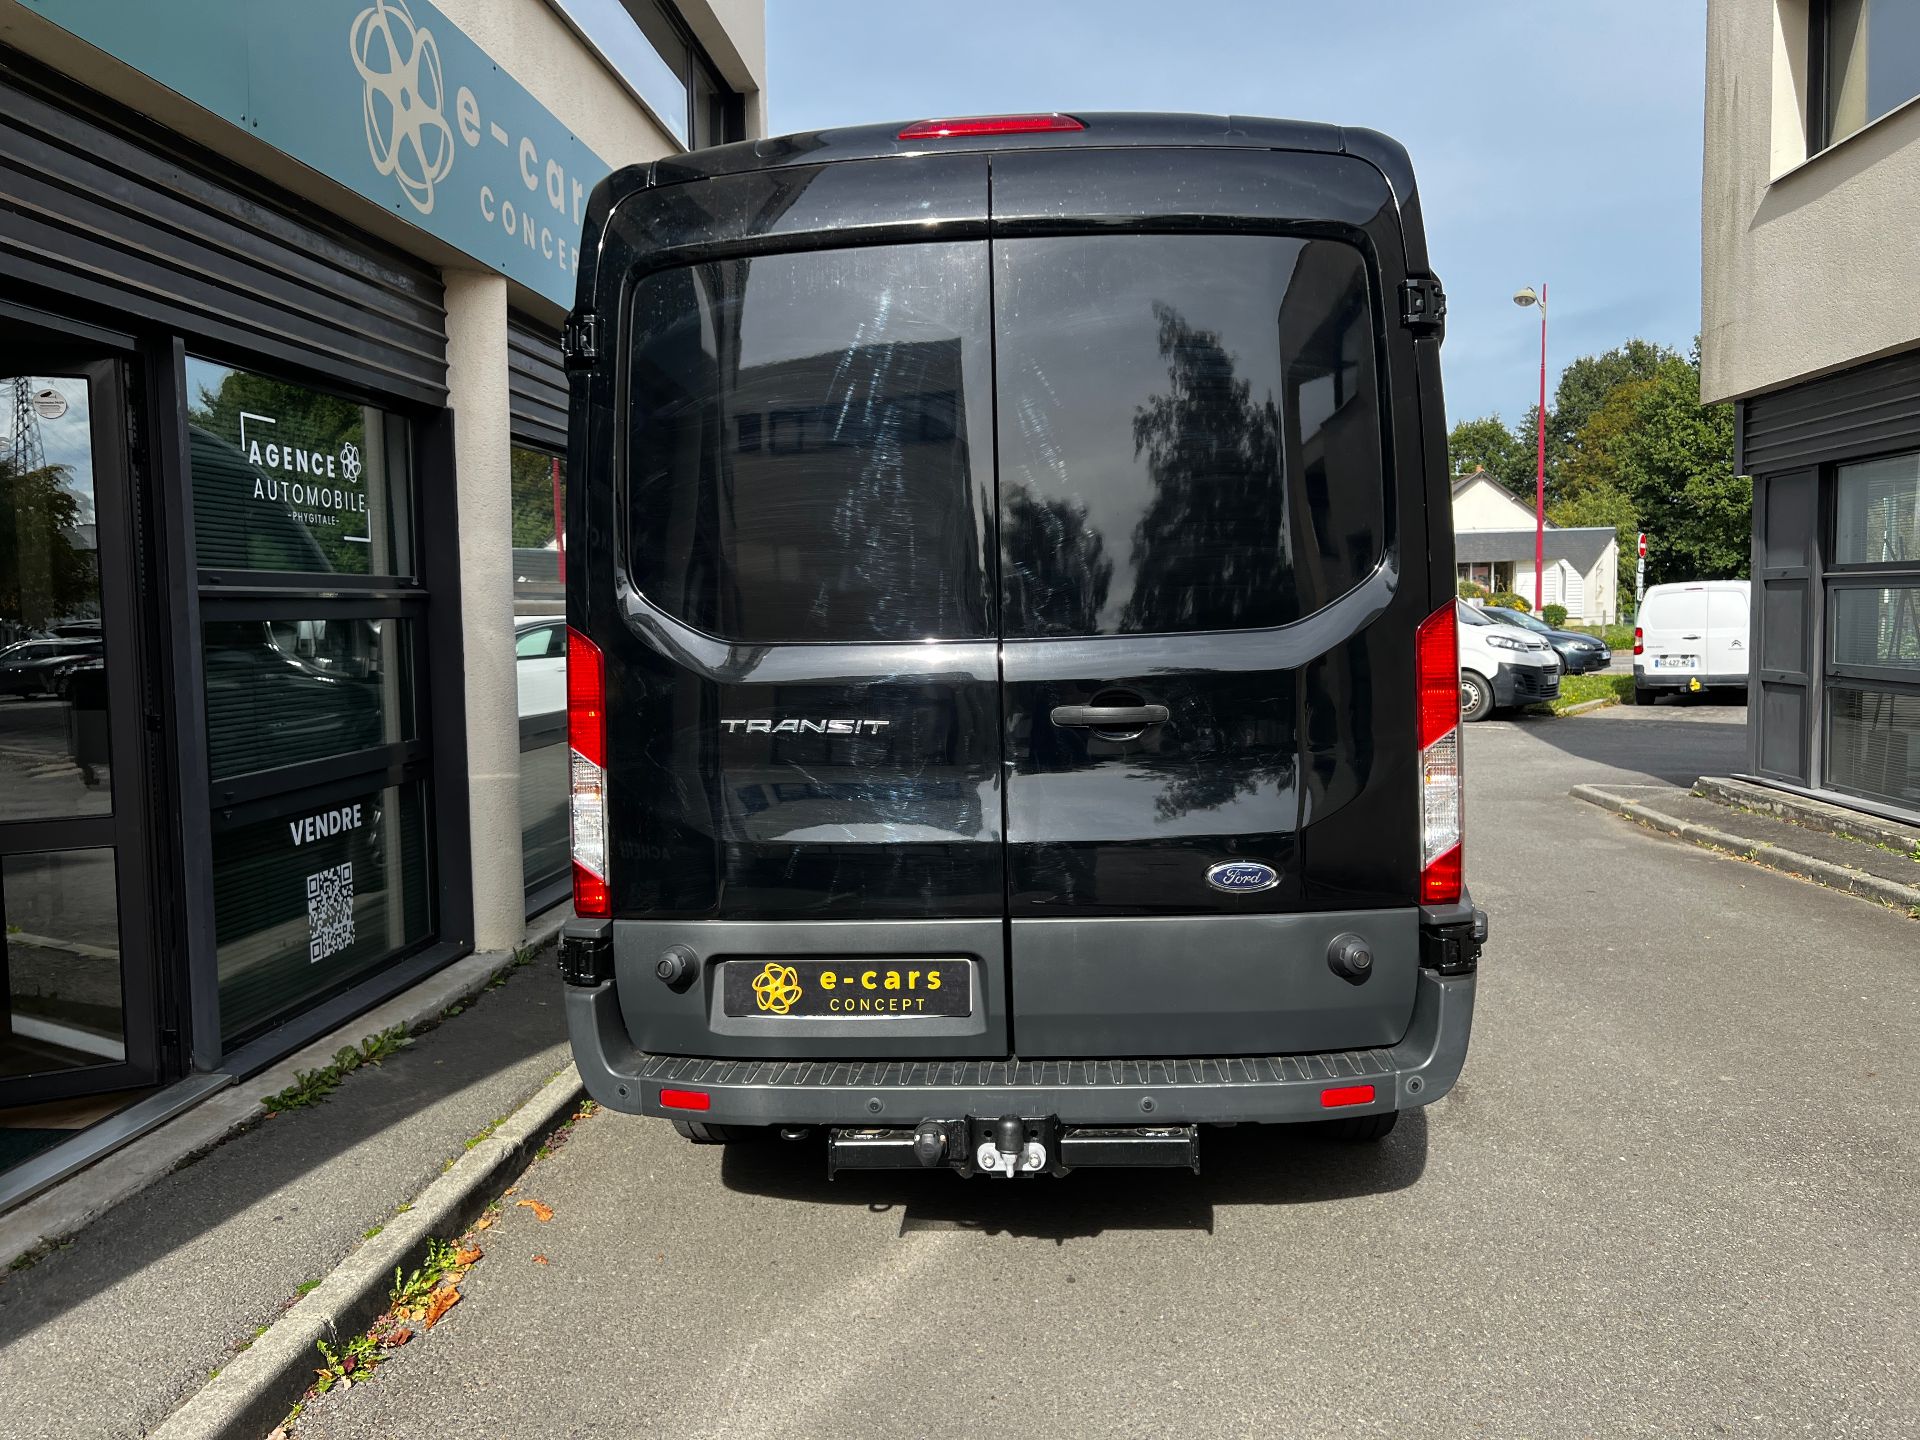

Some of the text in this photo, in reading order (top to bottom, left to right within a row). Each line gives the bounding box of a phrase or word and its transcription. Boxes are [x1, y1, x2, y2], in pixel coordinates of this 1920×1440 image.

[249, 441, 336, 479] AGENCE
[254, 478, 366, 513] AUTOMOBILE
[720, 719, 890, 735] TRANSIT
[290, 804, 362, 847] VENDRE
[1223, 868, 1262, 885] Ford
[820, 970, 942, 990] e-cars
[829, 998, 925, 1012] CONCEPT
